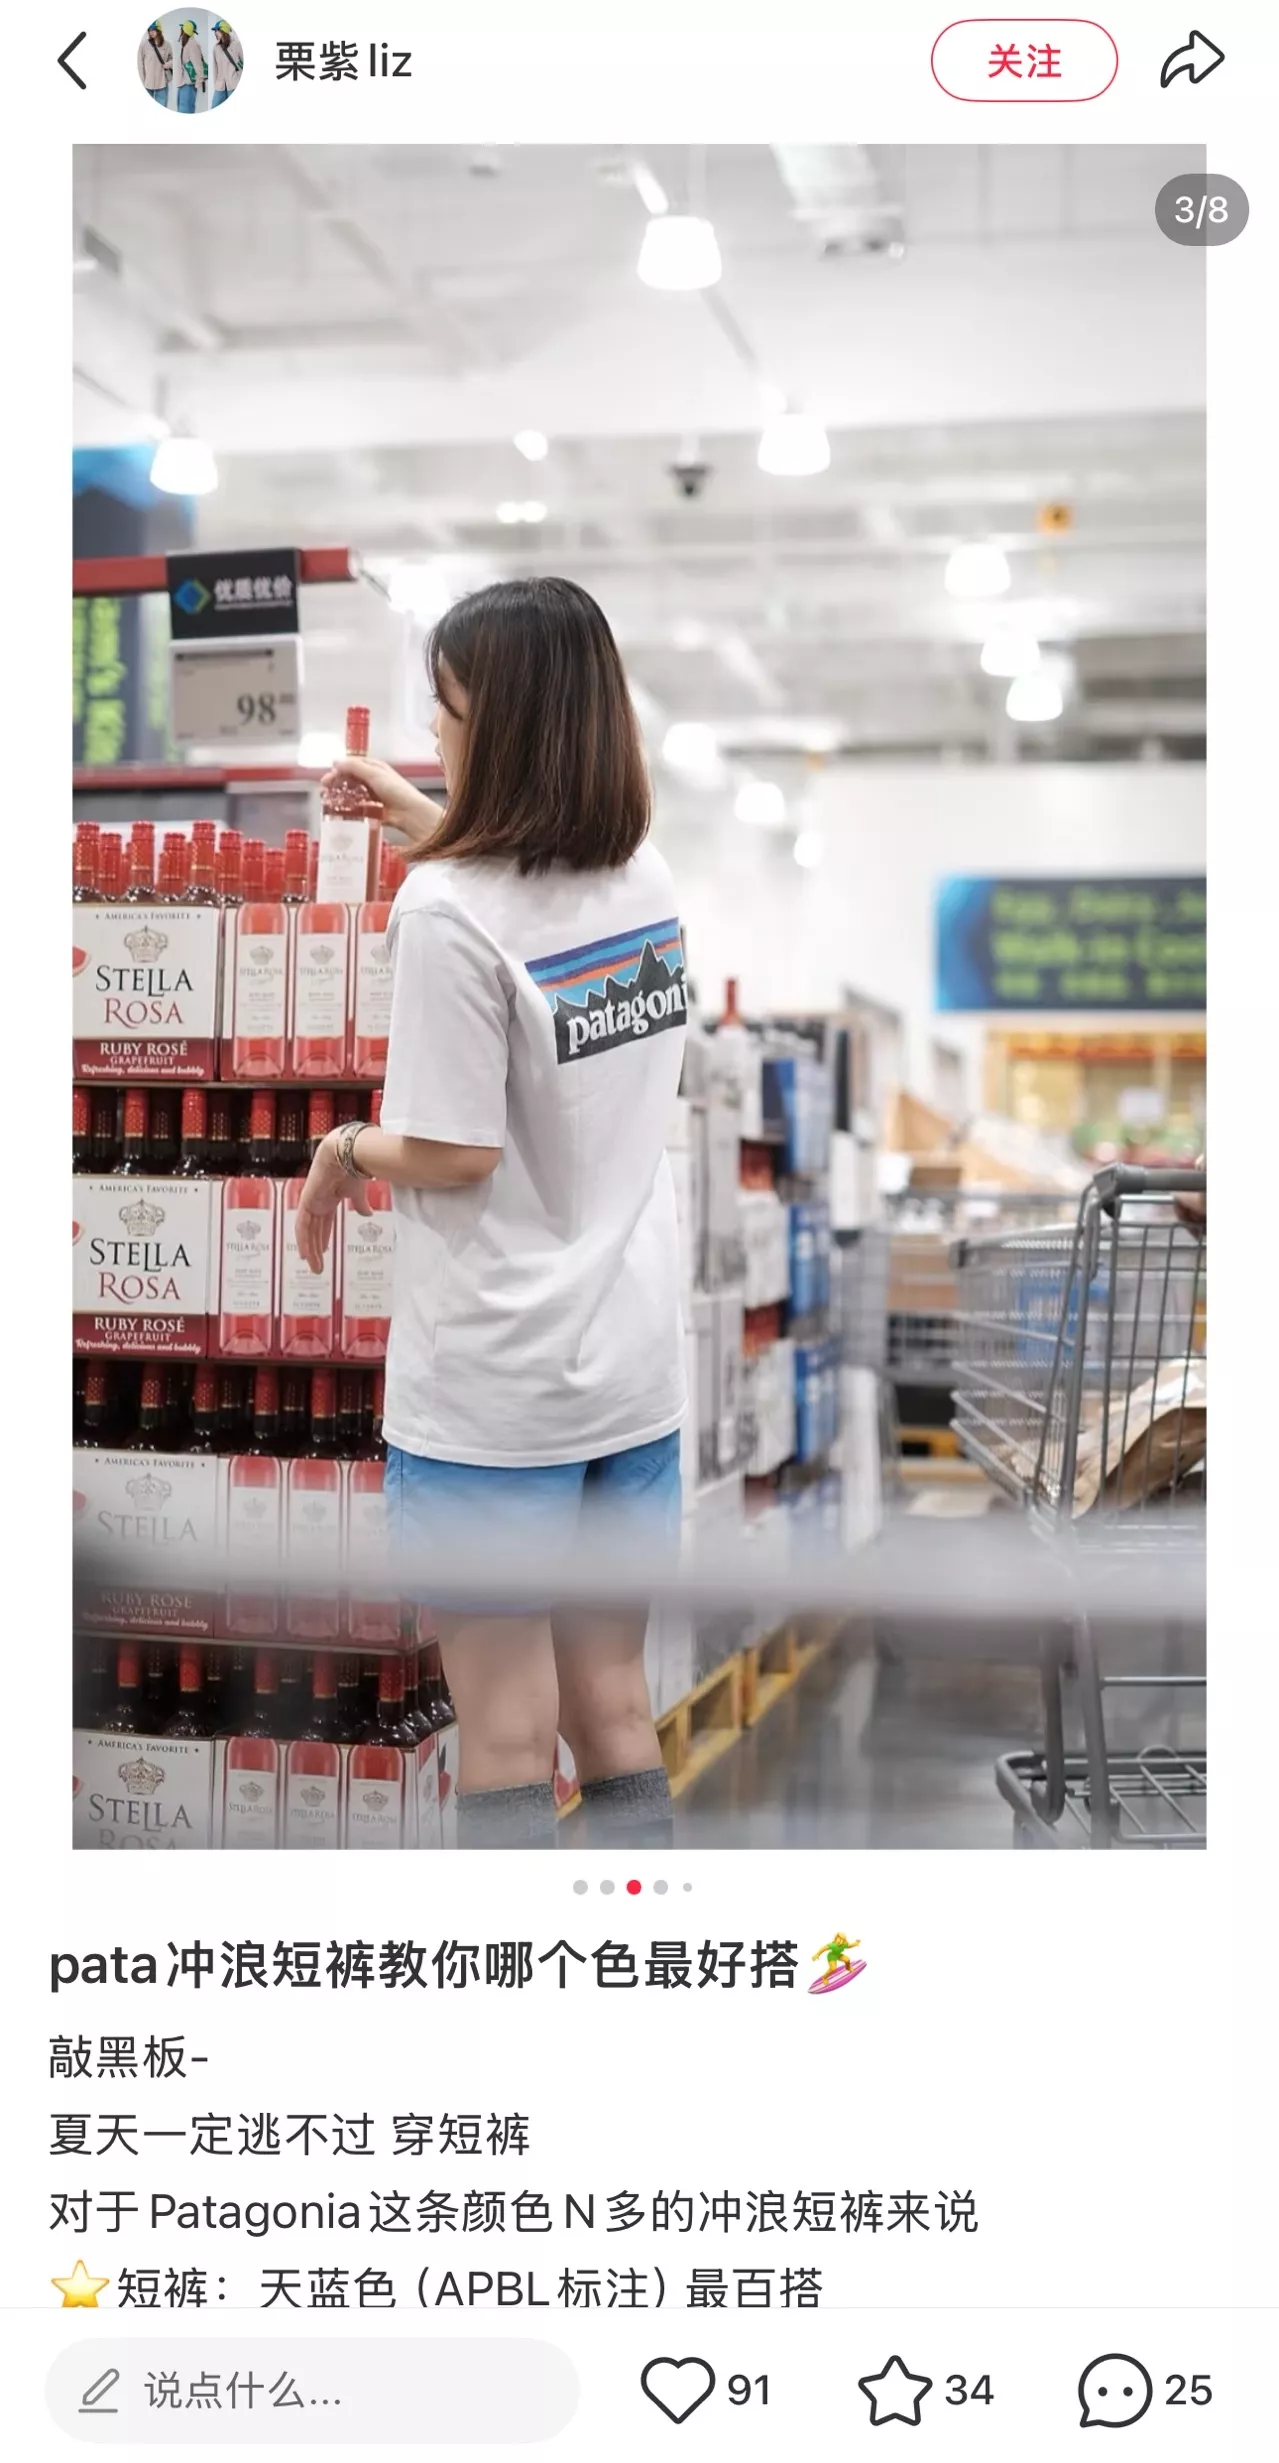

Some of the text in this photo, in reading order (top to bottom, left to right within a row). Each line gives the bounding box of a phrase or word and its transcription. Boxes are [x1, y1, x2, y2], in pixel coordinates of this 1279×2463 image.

[237, 692, 276, 725] 98
[96, 964, 194, 997] STELLA
[104, 997, 184, 1030] ROSA
[100, 1042, 143, 1056] RUBY
[110, 1056, 175, 1066] GRAPEFRUIT
[89, 1238, 192, 1272] STELLA
[98, 1271, 181, 1305] ROSA
[94, 1317, 139, 1332] RUBY
[105, 1331, 171, 1342] GRAPEFRUIT
[97, 1511, 198, 1546] STELLA
[146, 1743, 188, 1754] FAVORITE
[88, 1793, 193, 1833] STELLA
